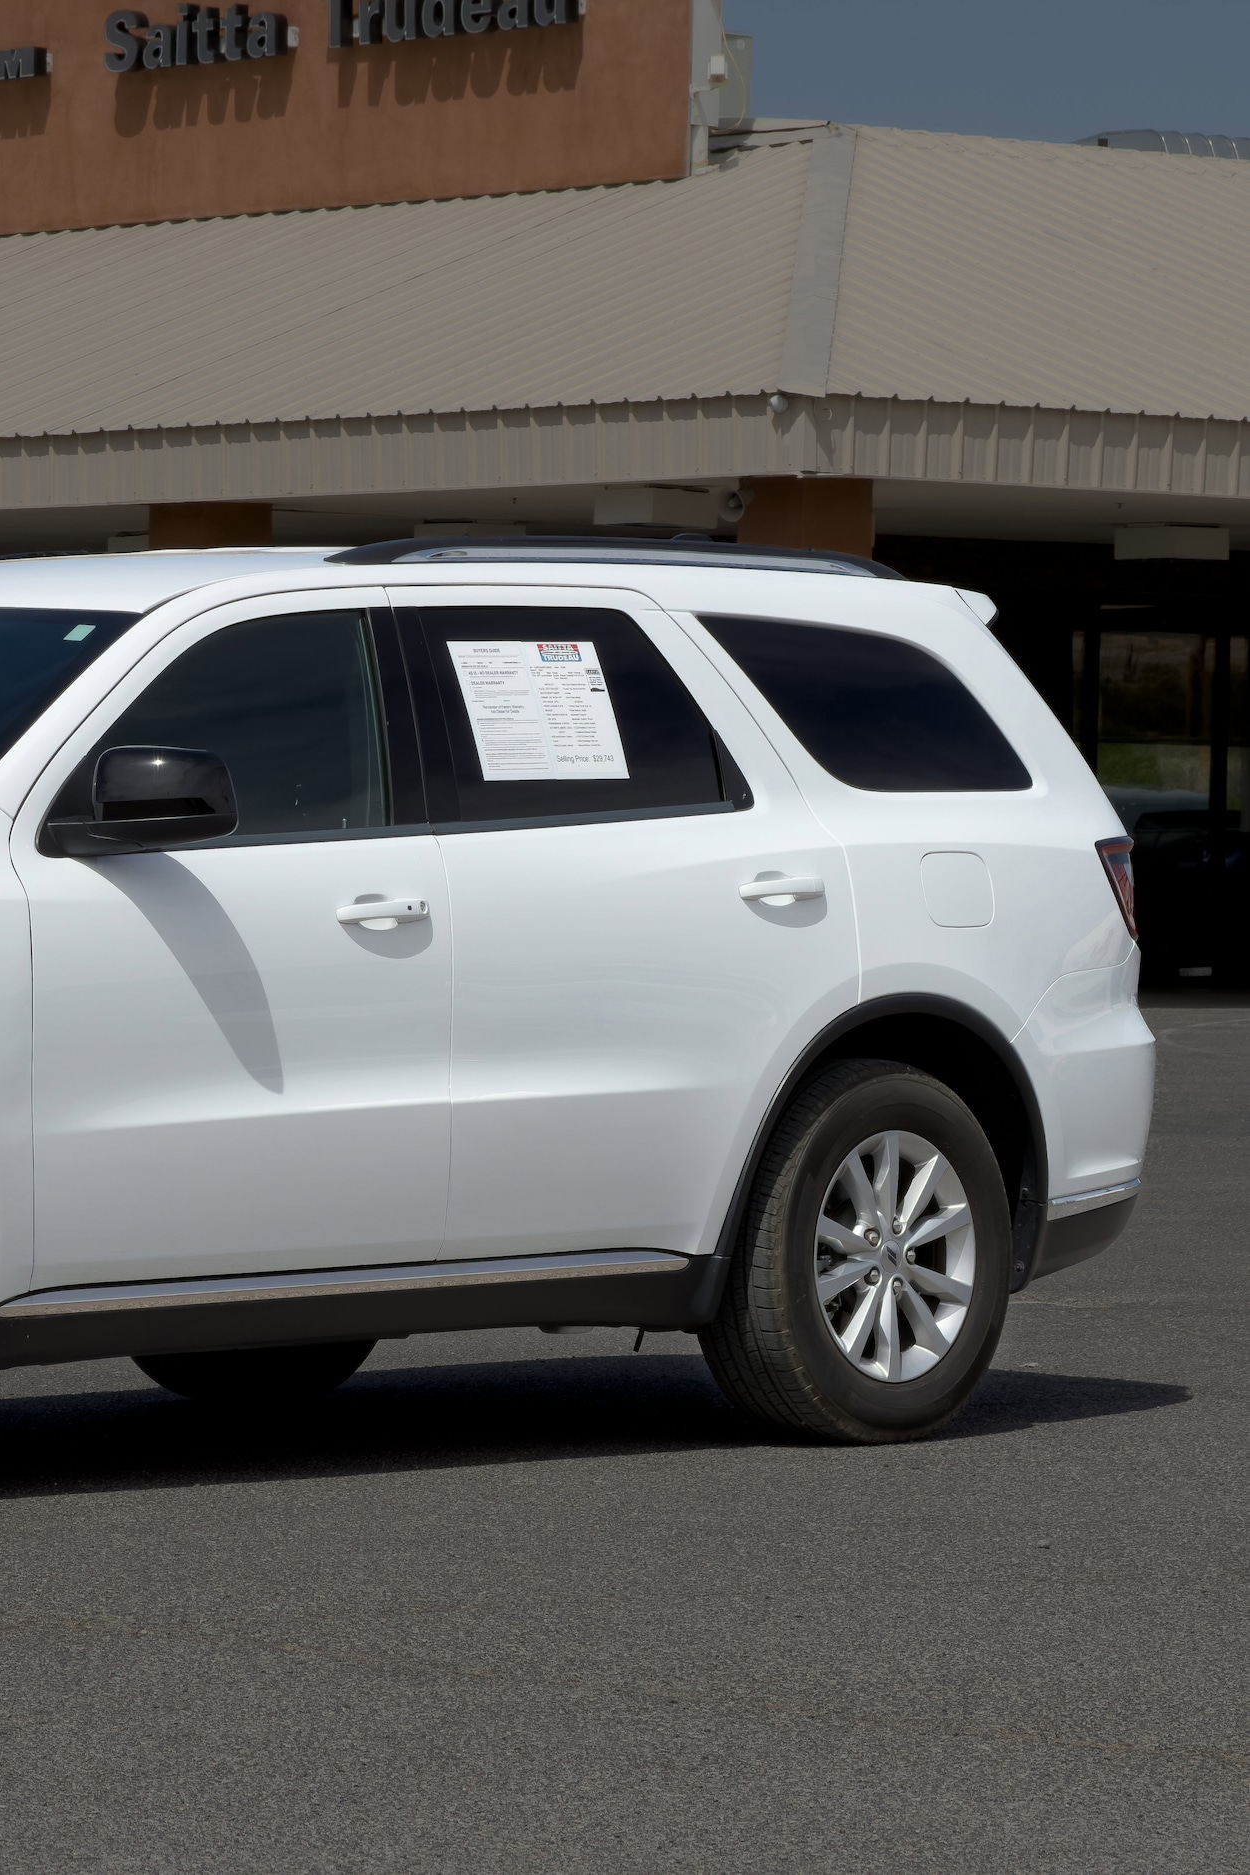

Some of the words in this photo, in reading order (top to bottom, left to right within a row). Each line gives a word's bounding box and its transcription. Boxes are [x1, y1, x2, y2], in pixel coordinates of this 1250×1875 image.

[103, 3, 278, 73] Saitta
[556, 755, 574, 764] Selling
[575, 754, 590, 762] Price:
[592, 754, 615, 763] $29,743
